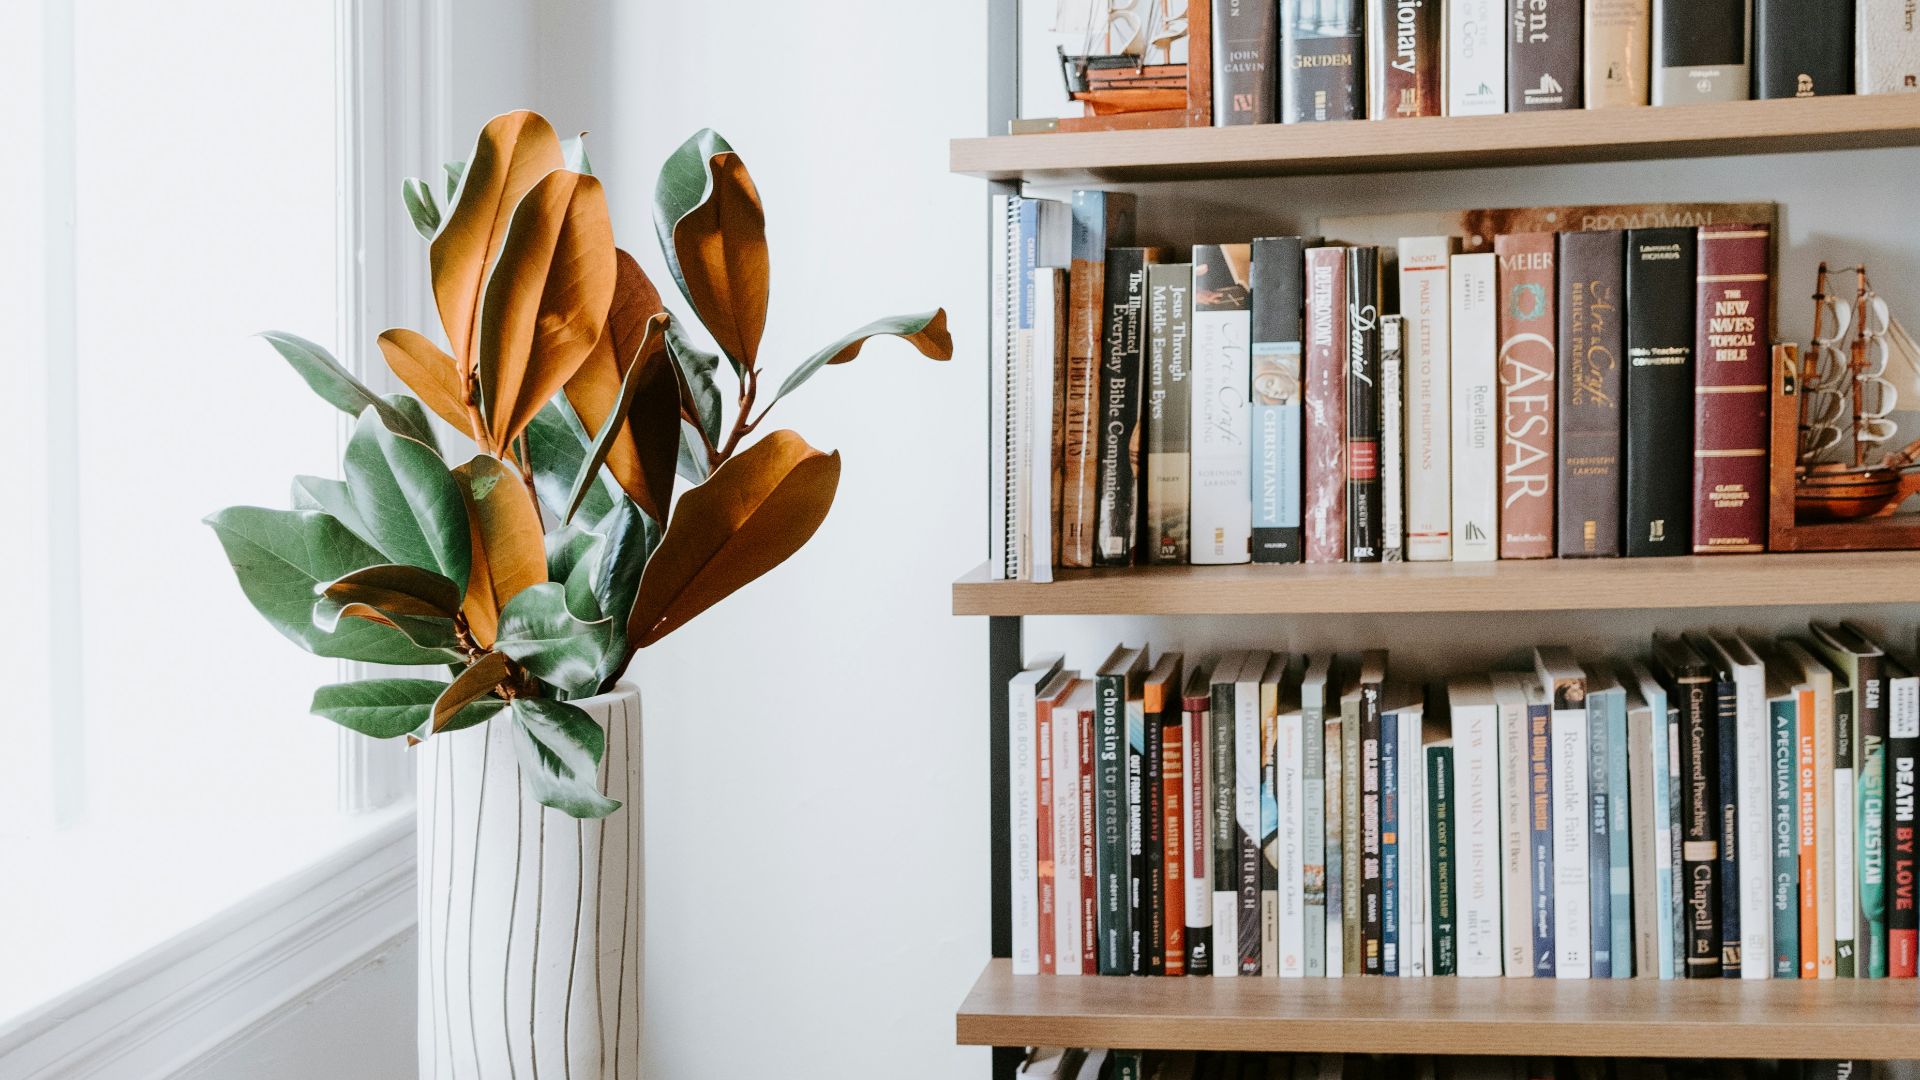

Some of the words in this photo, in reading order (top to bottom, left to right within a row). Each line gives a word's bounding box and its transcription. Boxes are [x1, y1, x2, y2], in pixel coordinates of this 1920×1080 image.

[1225, 63, 1264, 72] CALVIN
[1230, 51, 1258, 62] JOHN
[1291, 54, 1352, 69] GRUDEM
[1026, 237, 1035, 267] CHARTS
[1500, 253, 1553, 270] MEIER
[1026, 270, 1035, 280] OF
[1129, 270, 1142, 292] The
[1463, 273, 1472, 311] CAMPBELL
[1026, 284, 1035, 325] CHRISTIAN
[1152, 285, 1165, 333] Middle
[1170, 285, 1186, 318] Jesus
[1314, 266, 1331, 346] DEUTERONOMY
[1420, 279, 1431, 315] PAUL'S
[1572, 282, 1582, 333] BIBLICAL
[1716, 301, 1749, 316] NEW
[1725, 290, 1741, 298] THE
[1106, 303, 1128, 372] Everyday
[1127, 295, 1142, 354] Illustrated
[1421, 319, 1431, 357] LETTER
[1708, 335, 1755, 347] TOPICAL
[1710, 317, 1754, 332] NAVE'S
[1152, 338, 1165, 385] Eastern
[1169, 321, 1186, 381] Through
[1203, 324, 1213, 373] BIBLICAL
[1350, 303, 1377, 387] Daniel
[1716, 348, 1748, 362] BIBLE
[1070, 356, 1094, 401] BIBLE
[1386, 365, 1396, 397] DANIEL
[1421, 360, 1431, 375] TO
[1572, 337, 1582, 406] PREACHING
[1580, 346, 1615, 410] Craft
[1109, 378, 1125, 416] Bible
[1151, 390, 1165, 419] Eyes
[1421, 381, 1432, 398] THE
[1203, 377, 1214, 443] PREACHING
[1214, 386, 1244, 446] Craft
[1474, 385, 1488, 448] Revelation
[1499, 333, 1555, 509] CAESAR
[1068, 408, 1092, 457] ATLAS
[1421, 403, 1432, 470] PHILIPPIANS
[1104, 421, 1123, 510] Companion
[1262, 409, 1277, 522] CHRISTIANITY
[1746, 684, 1760, 727] Leading
[1865, 679, 1880, 708] DEAN
[1017, 711, 1028, 733] BIG
[1102, 688, 1120, 761] choosing
[1218, 725, 1226, 742] The
[1470, 719, 1481, 748] NEW
[1508, 712, 1517, 729] The
[1532, 716, 1547, 734] The
[1689, 688, 1705, 780] Christ-Centered
[1777, 715, 1787, 727] A
[1018, 736, 1028, 769] BOOK
[1149, 722, 1158, 777] reviewing
[1218, 744, 1226, 772] Drama
[1303, 710, 1319, 777] Preaching
[1384, 742, 1392, 755] the
[1508, 731, 1518, 754] Hard
[1532, 736, 1547, 761] Way
[1592, 709, 1605, 793] KINGDOM
[1747, 732, 1761, 749] the
[1801, 736, 1812, 764] LIFE
[1082, 774, 1092, 786] THE
[1105, 766, 1117, 783] to
[1130, 755, 1141, 774] OUT
[1192, 740, 1201, 783] GROWING
[1218, 775, 1227, 785] of
[1346, 747, 1356, 776] SHORT
[1381, 756, 1395, 794] pastor's
[1534, 763, 1547, 773] of
[1563, 732, 1577, 810] Reasonable
[1777, 730, 1789, 800] PECULIAR
[1802, 768, 1813, 788] ON
[1864, 734, 1883, 797] ALMOST
[1130, 776, 1141, 803] FROM
[1167, 794, 1178, 808] THE
[1193, 786, 1201, 803] TRUE
[1285, 767, 1295, 813] Documents
[1307, 781, 1319, 803] the
[1346, 780, 1356, 817] HISTORY
[1470, 759, 1483, 836] TESTAMENT
[1534, 775, 1548, 792] the
[1895, 757, 1914, 821] DEATH
[1018, 790, 1028, 828] SMALL
[1083, 787, 1092, 832] IMITATION
[1103, 789, 1120, 844] preach
[1217, 786, 1230, 841] Scripture
[1285, 815, 1296, 824] of
[1346, 819, 1356, 830] OF
[1436, 803, 1446, 818] THE
[1534, 794, 1548, 831] Master
[1594, 796, 1605, 835] FIRST
[1691, 782, 1706, 836] Preaching
[1803, 792, 1813, 846] MISSION
[1083, 835, 1092, 845] OF
[1130, 804, 1141, 855] DARKNESS
[1167, 815, 1179, 856] MASTER'S
[1193, 805, 1202, 852] DISCIPLES
[1286, 827, 1296, 841] the
[1307, 806, 1320, 862] Parables
[1346, 832, 1356, 851] THE
[1437, 821, 1447, 844] COST
[1564, 816, 1578, 853] Faith
[1749, 821, 1763, 861] Church
[1778, 804, 1790, 858] PEOPLE
[1864, 798, 1883, 884] CHRISTIAN
[1896, 827, 1914, 854] BY
[1019, 833, 1029, 881] GROUPS
[1083, 847, 1093, 877] CHRIST
[1286, 843, 1296, 882] Christian
[1347, 853, 1357, 878] EARLY
[1385, 854, 1396, 879] brian
[1437, 846, 1447, 858] OF
[1168, 862, 1179, 880] MEN
[1243, 837, 1256, 910] CHURCH
[1471, 843, 1484, 901] HISTORY
[1896, 860, 1914, 910] LOVE
[1109, 874, 1120, 912] anderson
[1286, 885, 1297, 916] Church
[1346, 880, 1357, 919] CHURCH
[1438, 862, 1448, 919] DISCIPLESHIP
[1689, 864, 1712, 930] Chapell
[1775, 873, 1791, 910] Clapp
[1467, 910, 1478, 947] BRUCE
[1512, 947, 1523, 963] IVP
